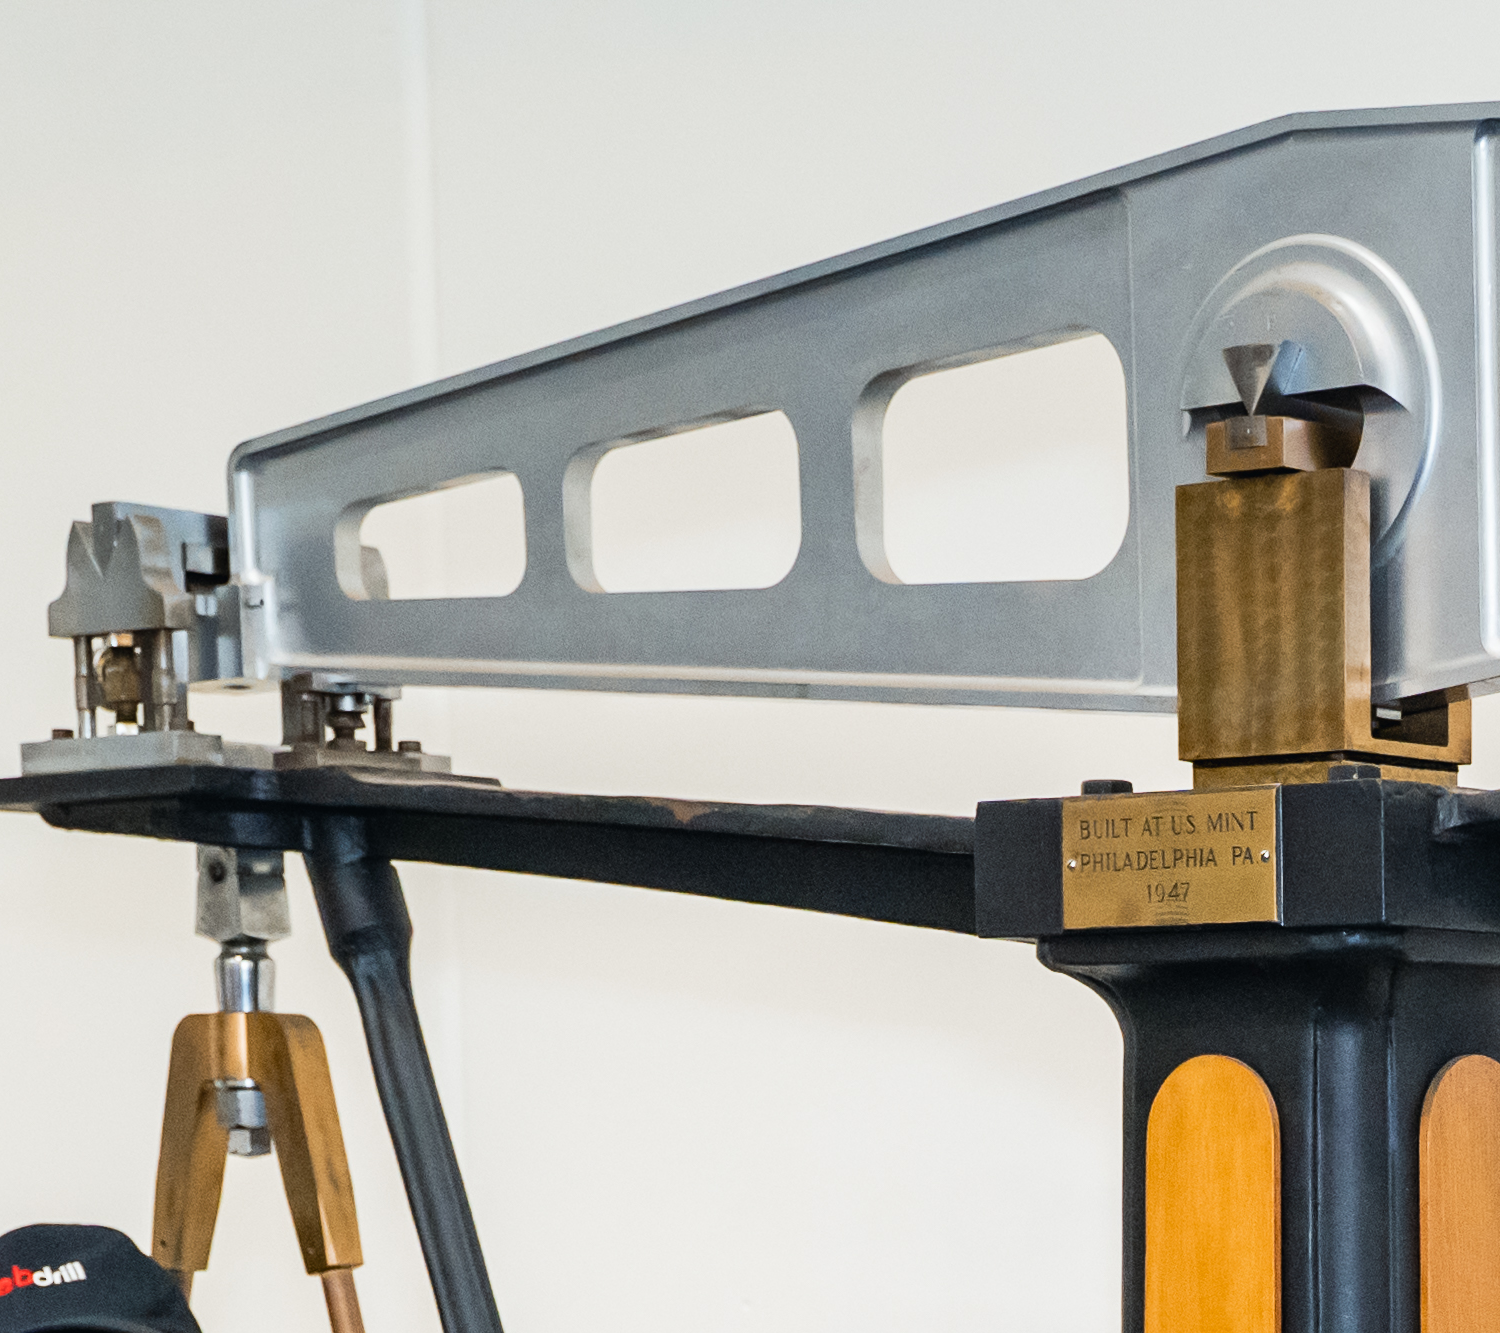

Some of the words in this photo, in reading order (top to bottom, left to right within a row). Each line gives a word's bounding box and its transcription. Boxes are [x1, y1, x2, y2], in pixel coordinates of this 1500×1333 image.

[1080, 818, 1132, 840] BUILT
[1141, 816, 1163, 837] AT
[1207, 811, 1258, 833] MINT
[1080, 847, 1218, 873] PHILADELPHIA
[1146, 882, 1190, 904] 1947
